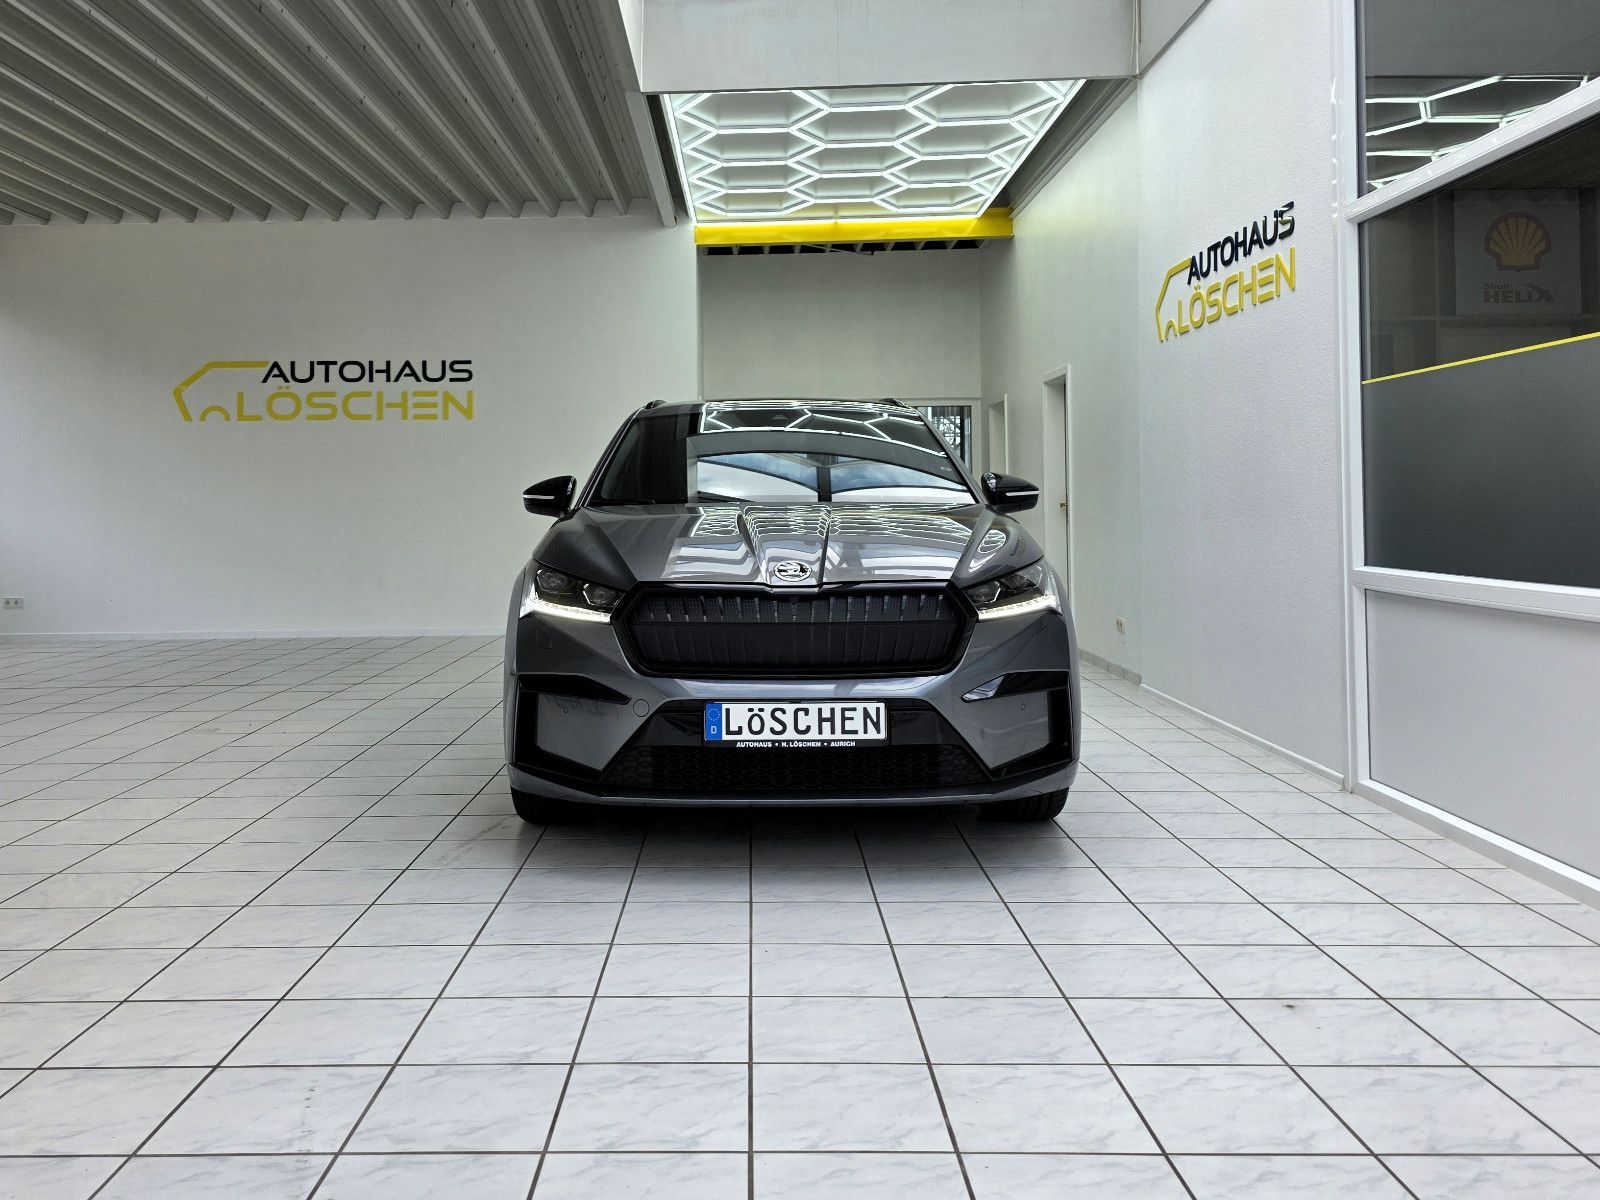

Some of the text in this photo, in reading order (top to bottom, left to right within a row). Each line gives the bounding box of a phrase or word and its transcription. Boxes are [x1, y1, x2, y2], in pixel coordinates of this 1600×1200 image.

[1187, 201, 1295, 285] AUTOHAUS
[1178, 246, 1296, 335] LÖSCHEN
[261, 360, 473, 383] AUTOHAUS
[237, 385, 474, 421] LÖSCHEN
[710, 725, 717, 734] D
